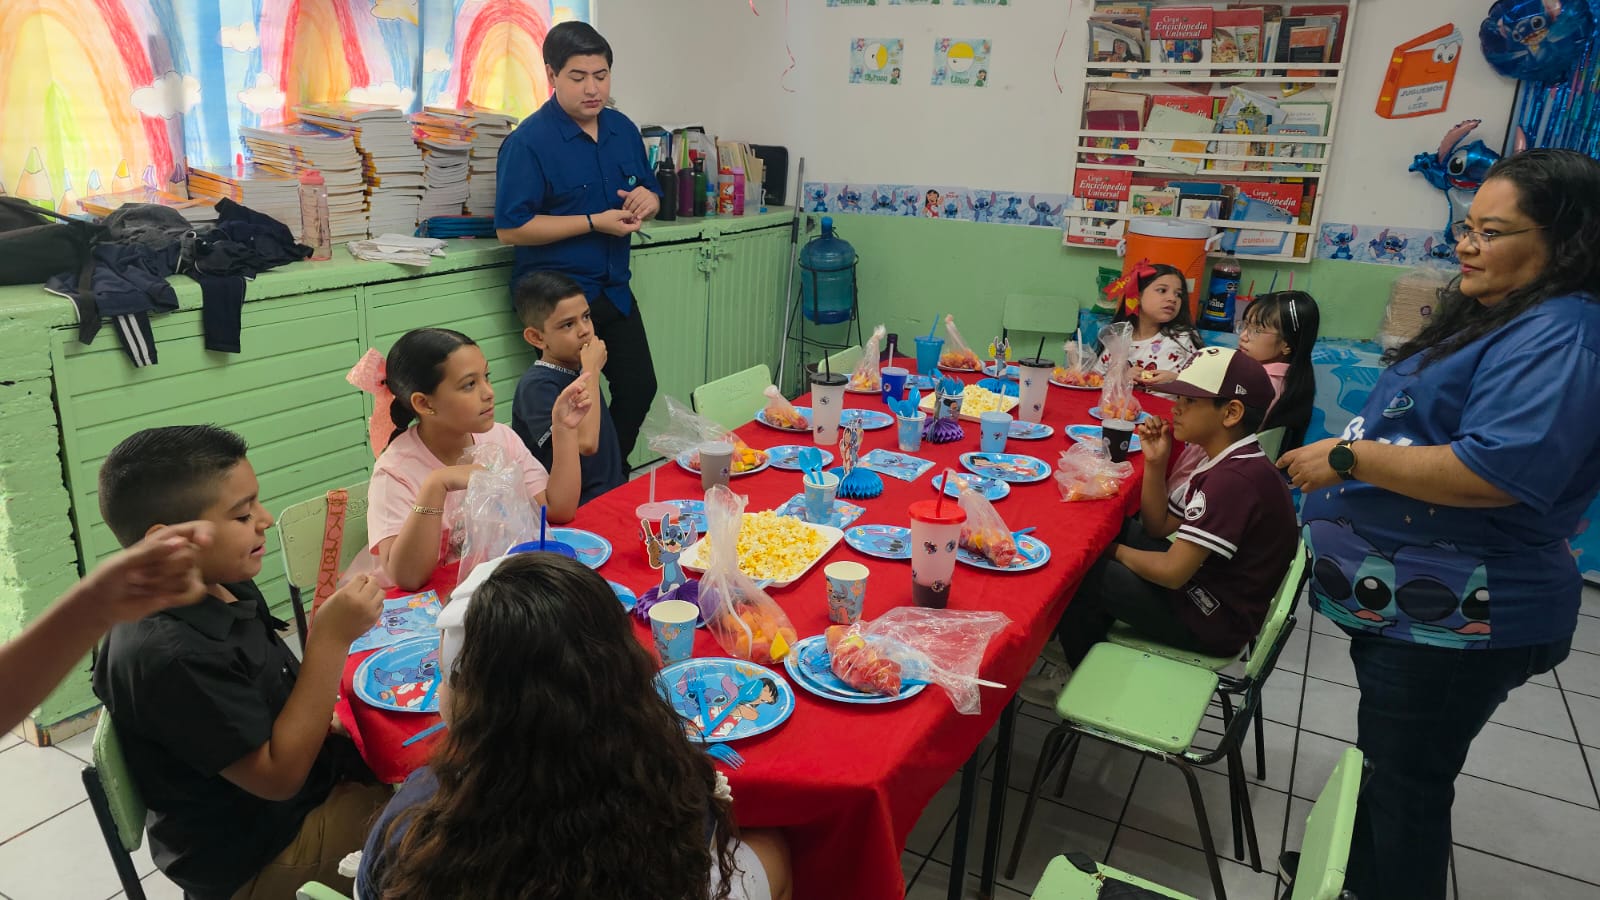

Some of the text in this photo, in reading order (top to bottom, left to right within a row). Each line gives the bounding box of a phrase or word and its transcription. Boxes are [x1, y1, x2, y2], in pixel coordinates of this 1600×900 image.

[1155, 22, 1208, 32] Enciclopedia
[1400, 84, 1443, 97] JUGUEMOS
[1079, 180, 1127, 192] Enciclopedia
[1088, 189, 1120, 198] Universal
